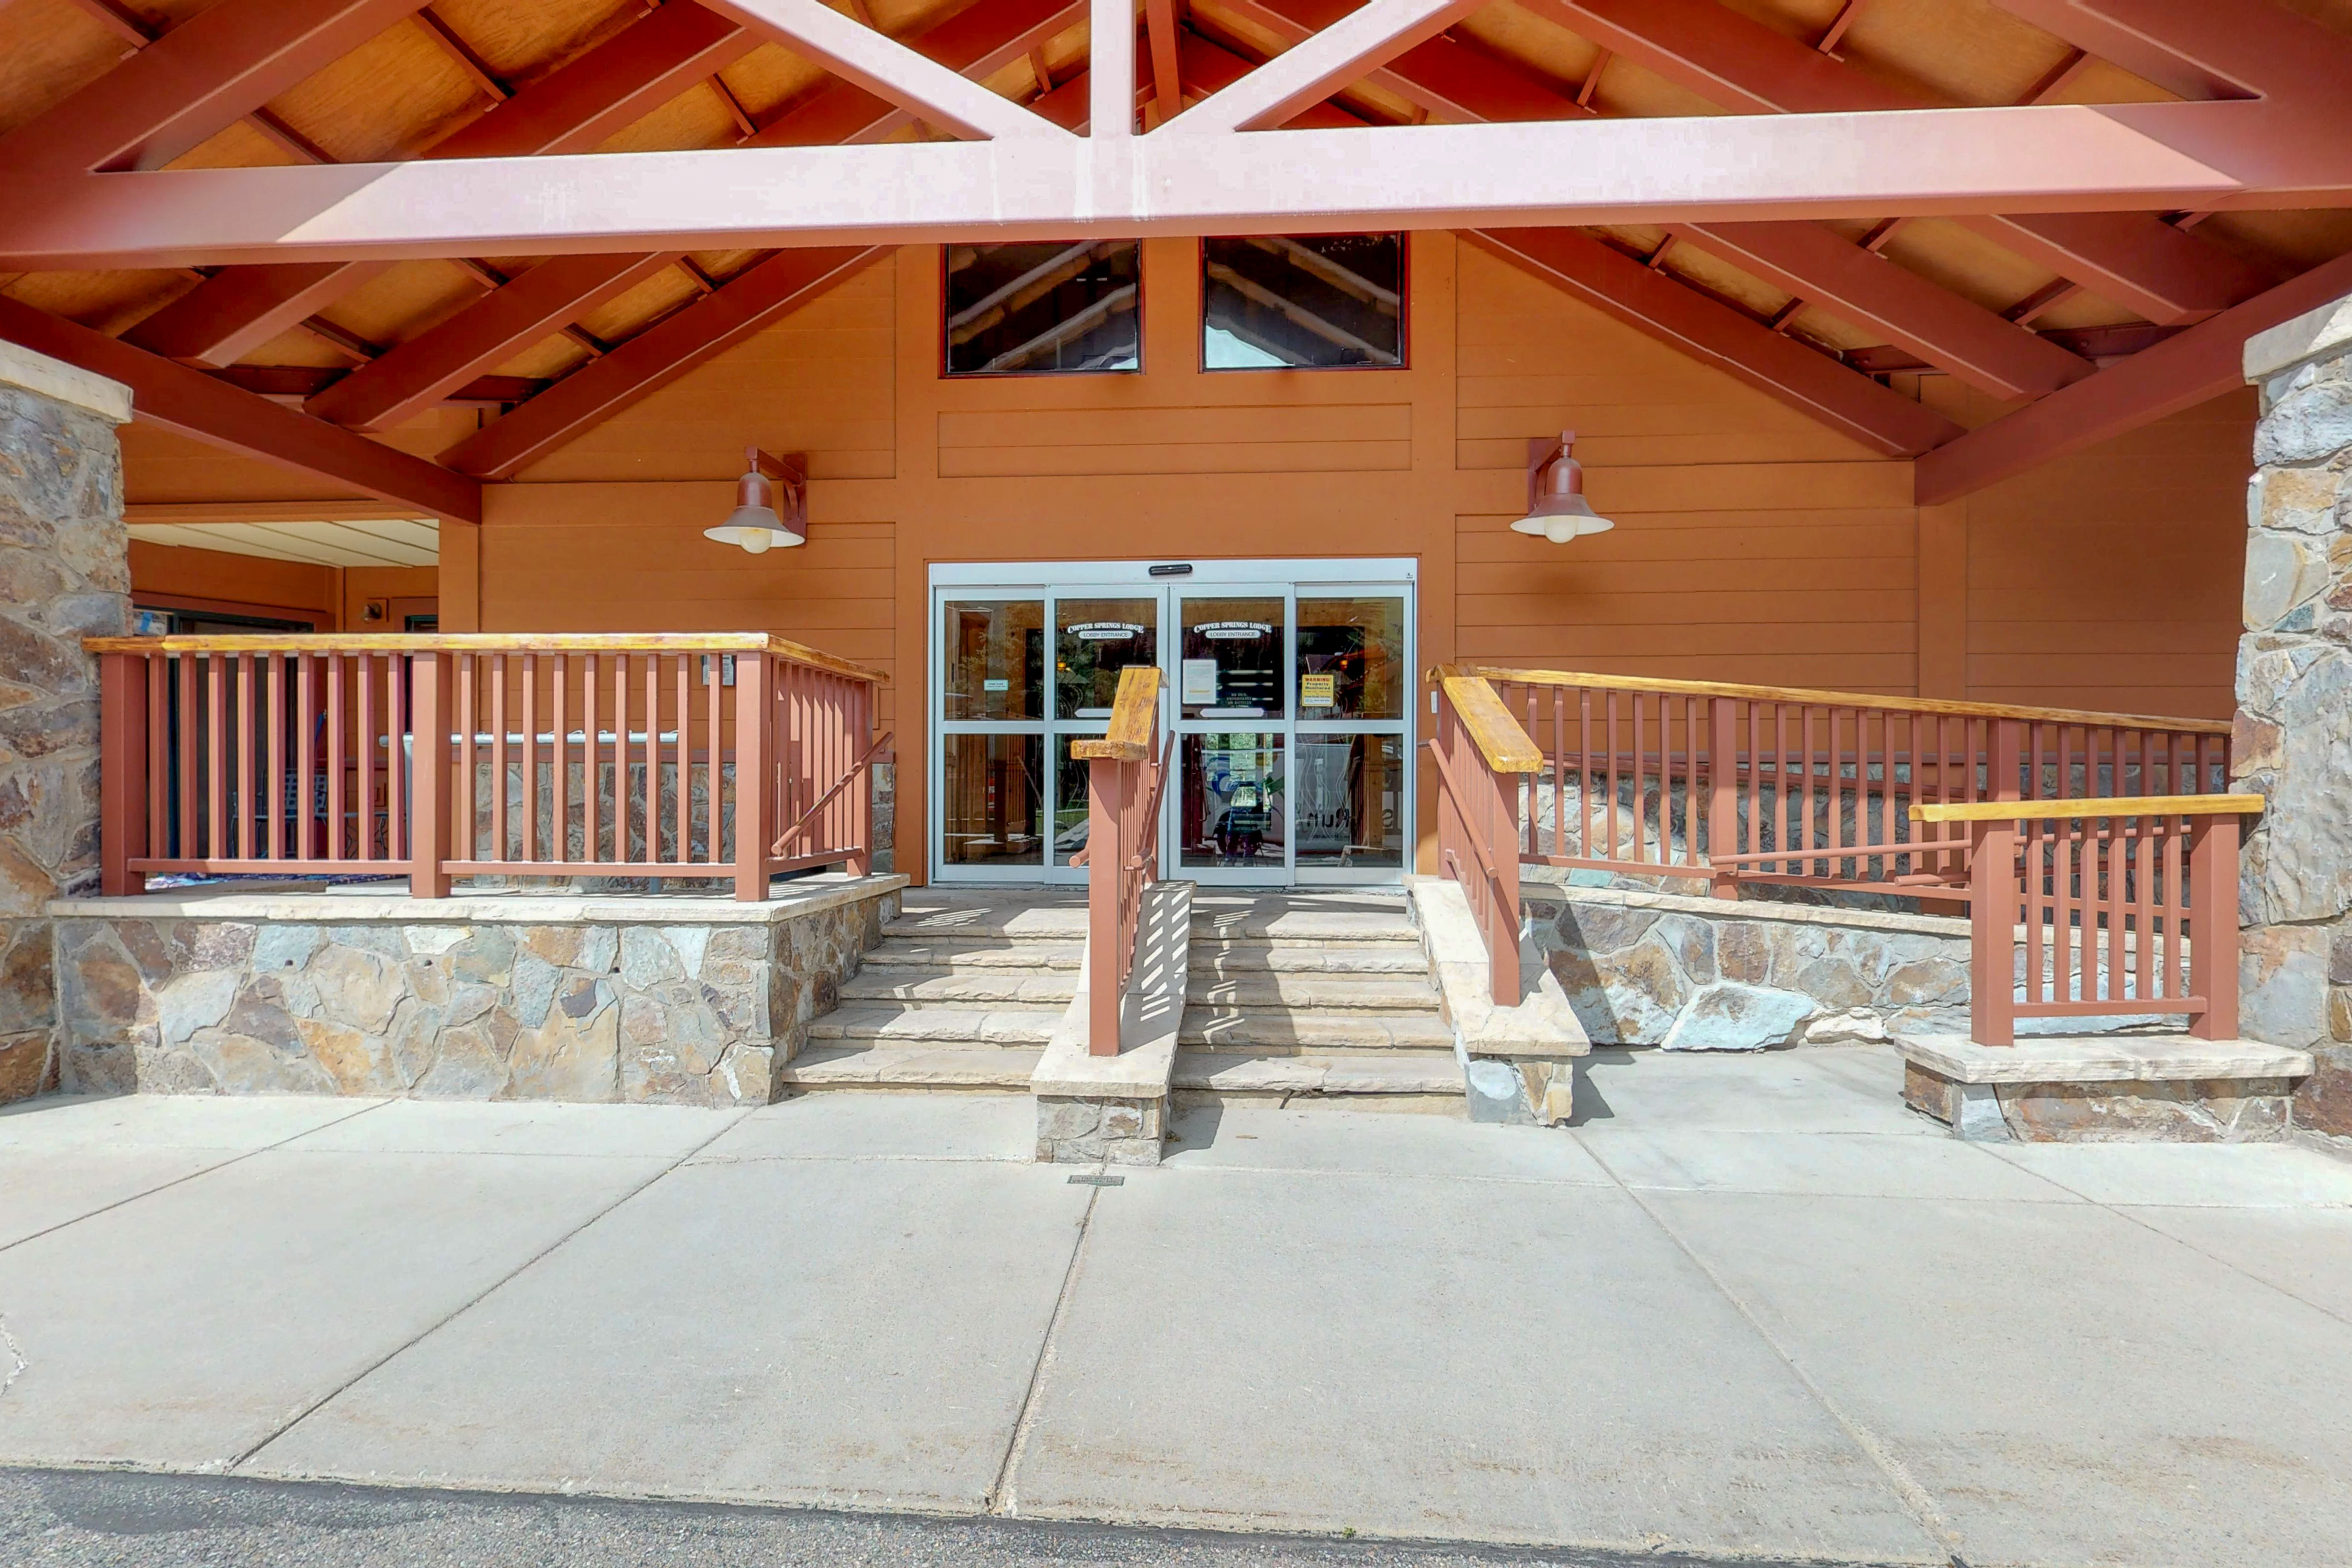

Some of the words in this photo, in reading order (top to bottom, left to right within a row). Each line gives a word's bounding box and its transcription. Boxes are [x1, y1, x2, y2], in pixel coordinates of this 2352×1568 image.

[1067, 623, 1093, 634] COPPER
[1122, 623, 1145, 634] LODGE
[1194, 622, 1220, 633] COPPER
[1249, 622, 1272, 633] LODGE
